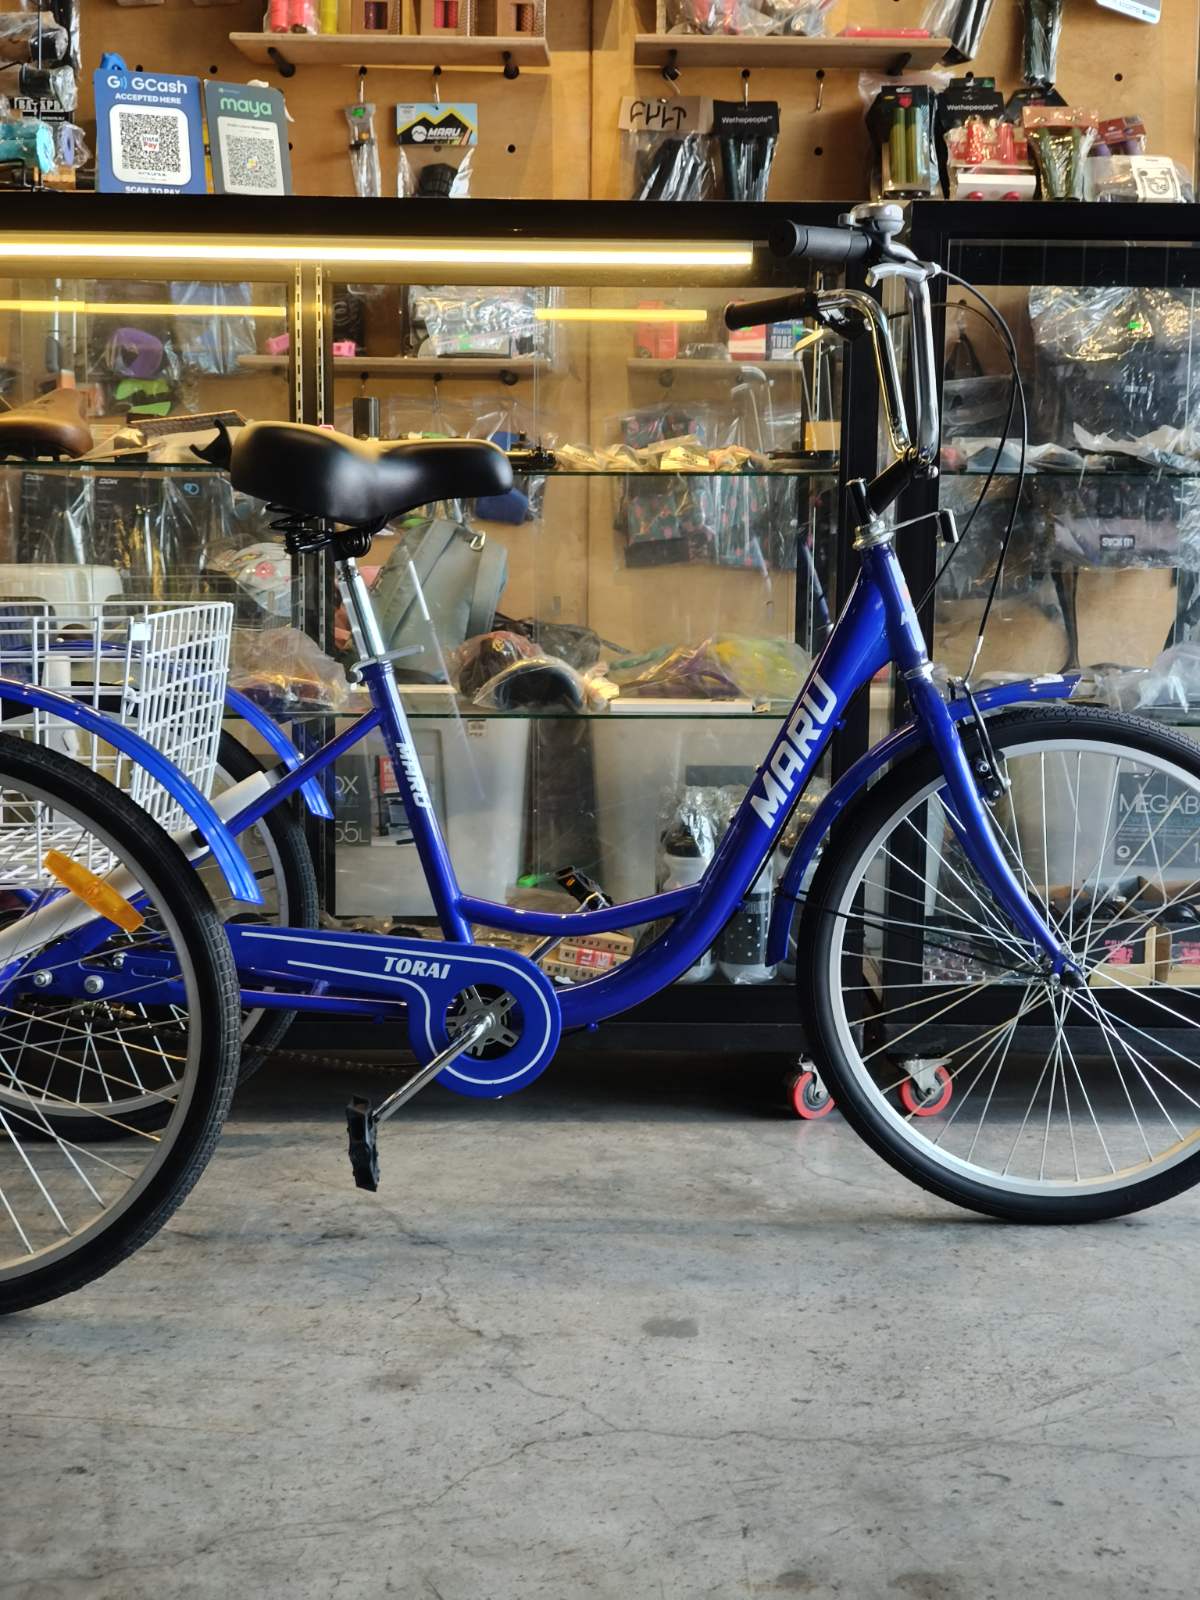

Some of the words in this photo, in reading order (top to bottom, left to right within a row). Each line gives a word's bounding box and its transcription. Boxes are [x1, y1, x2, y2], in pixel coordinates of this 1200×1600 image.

[131, 77, 188, 94] GCash
[114, 92, 159, 103] ACCEPTED
[159, 95, 182, 105] HERE
[220, 97, 272, 118] maya
[427, 127, 462, 137] MARU
[125, 186, 150, 195] SCAN
[151, 187, 163, 195] TO
[750, 672, 838, 829] MARU
[395, 742, 433, 809] MARU
[384, 956, 451, 980] TORAI
